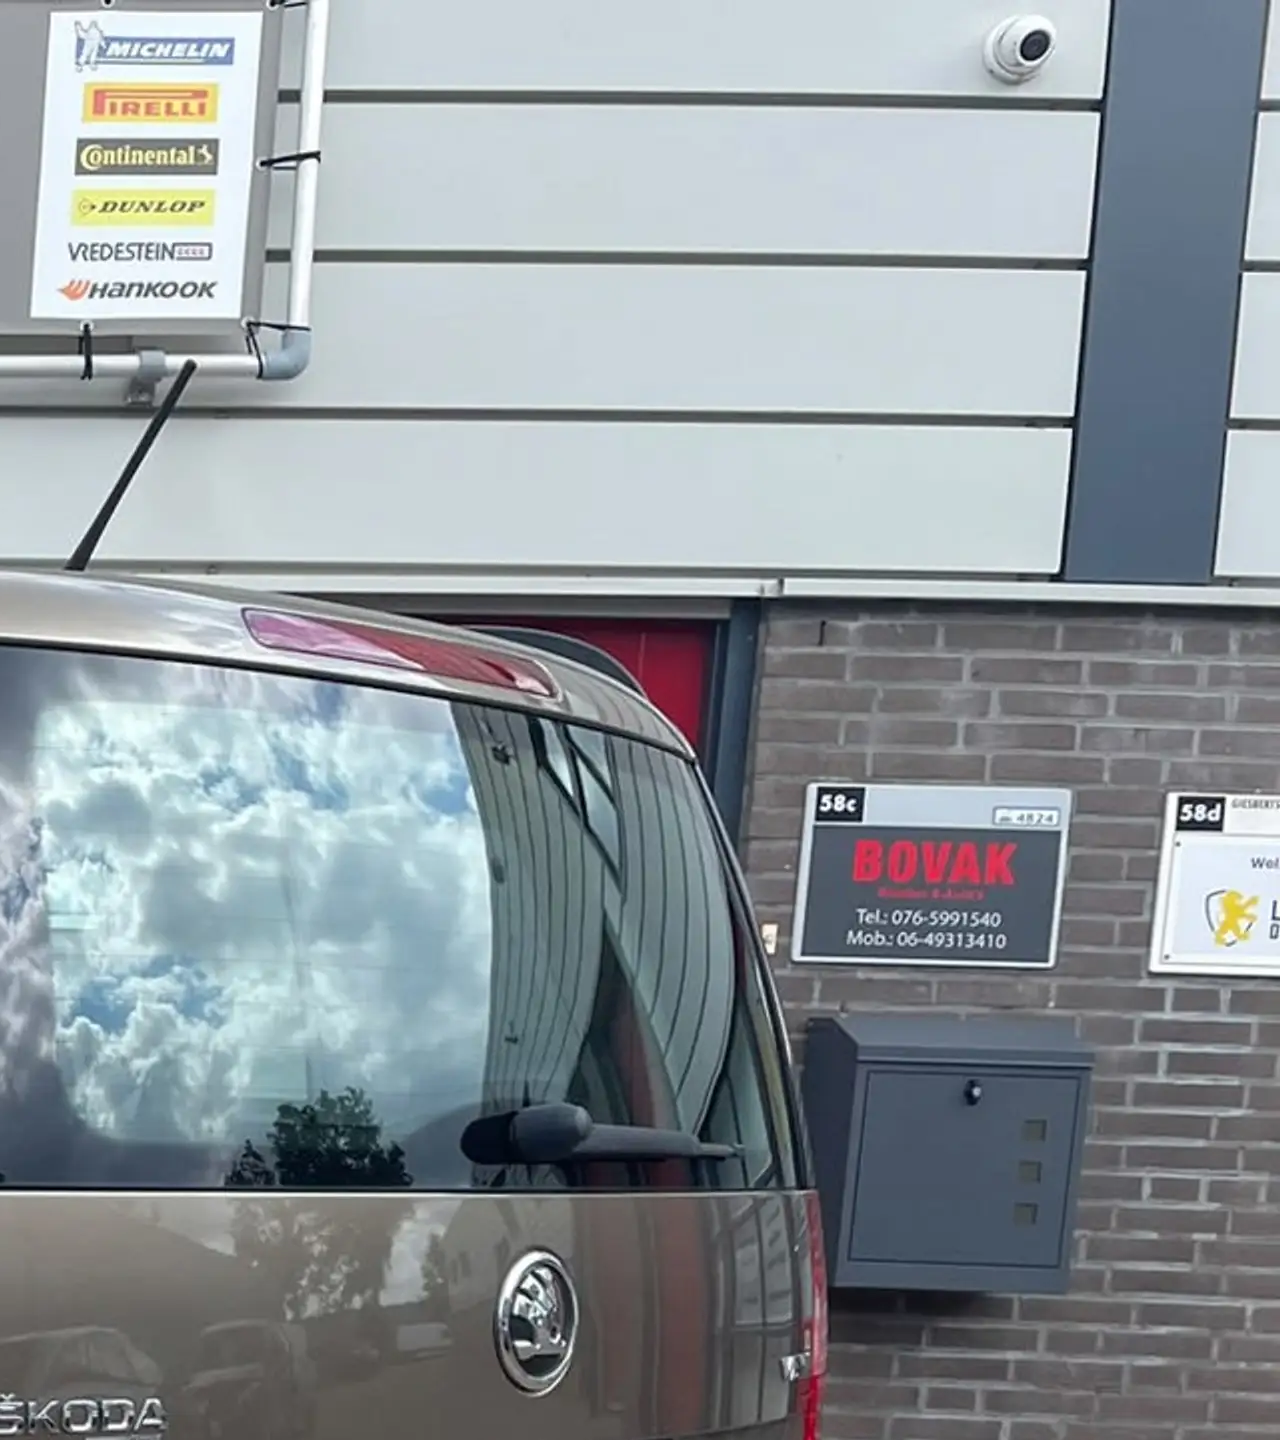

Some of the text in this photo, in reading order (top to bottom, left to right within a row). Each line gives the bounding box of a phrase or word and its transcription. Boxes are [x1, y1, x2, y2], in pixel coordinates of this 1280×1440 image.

[106, 40, 230, 58] MICHELIN
[92, 89, 208, 116] PIRELLI
[80, 144, 195, 170] Continental
[98, 200, 205, 213] DUNLOP
[67, 242, 175, 261] VREDESTEIN
[819, 794, 857, 813] 58c
[1180, 803, 1221, 822] 58d
[852, 839, 1018, 886] BOVAK
[856, 908, 1001, 928] Tel.: 076-5991540
[847, 930, 1007, 949] Mob.: 06-49313410
